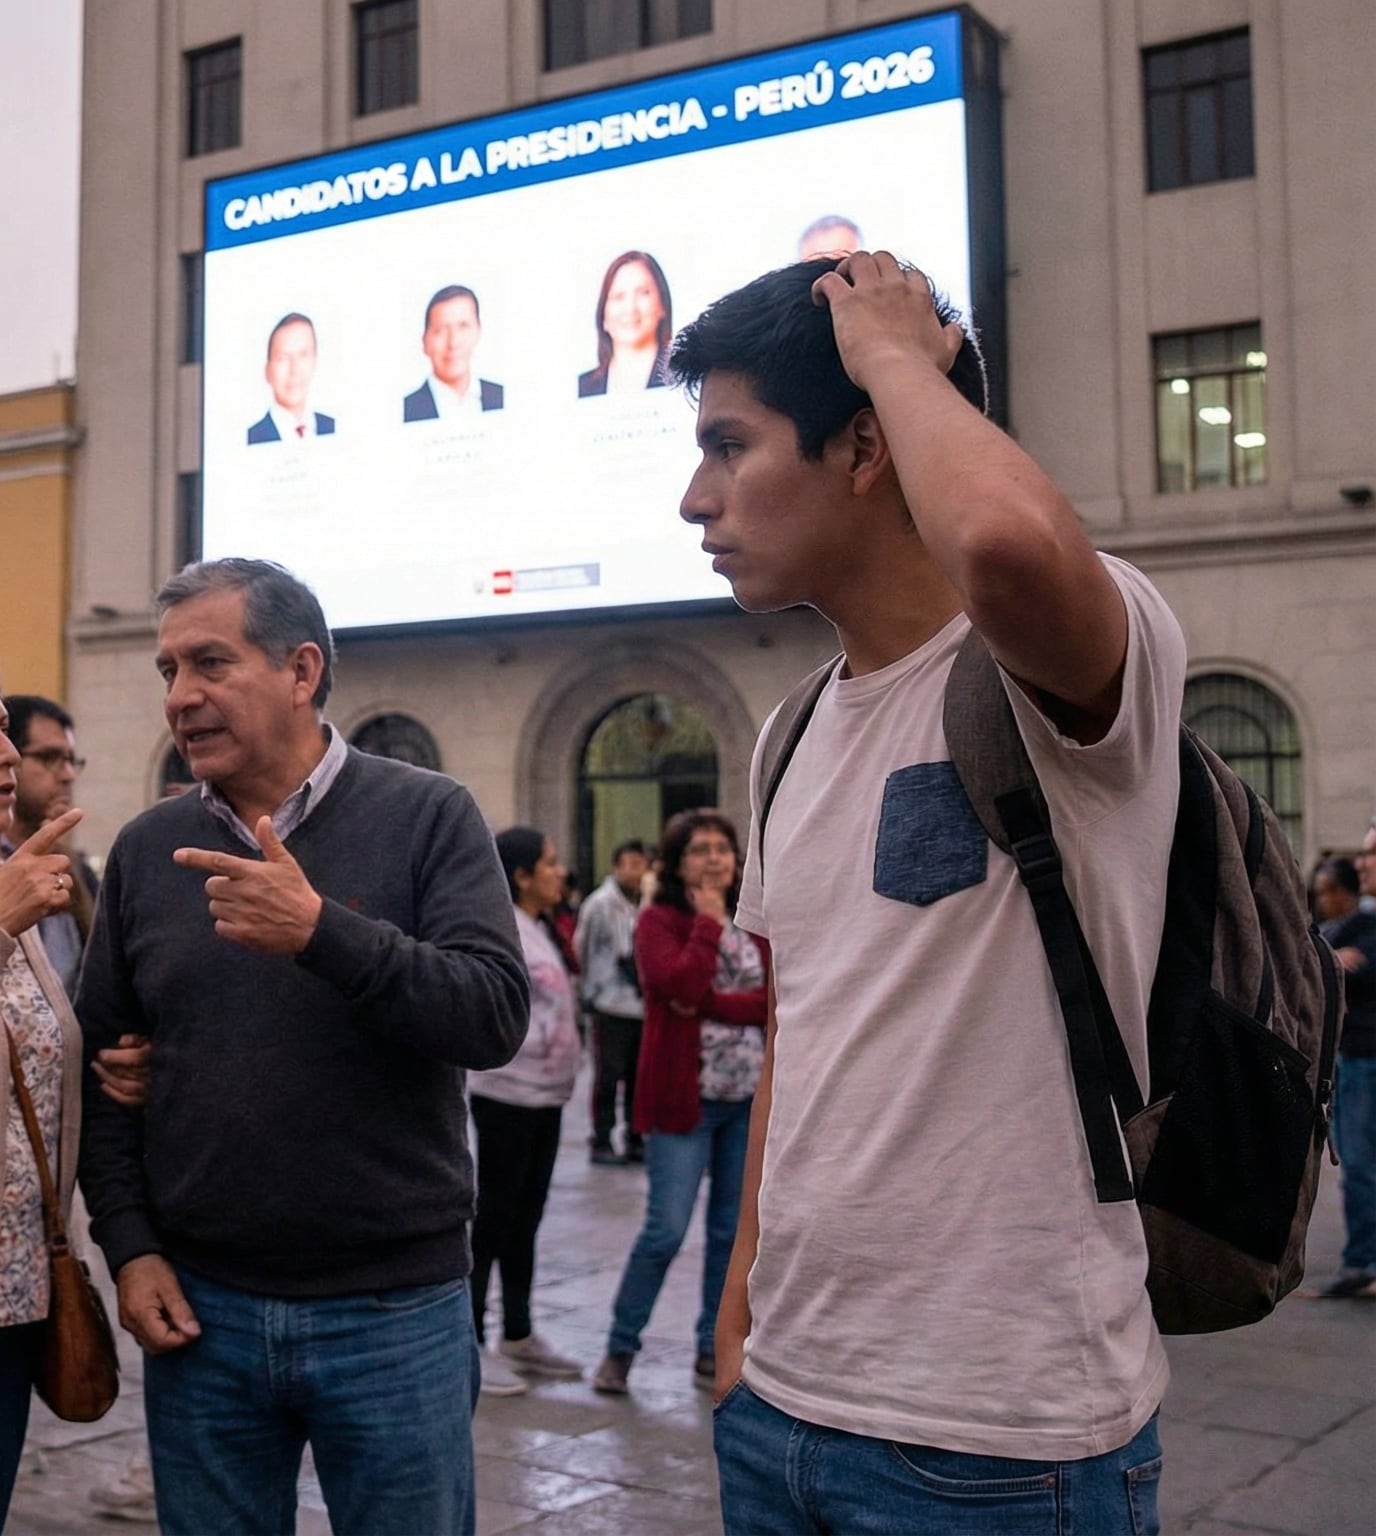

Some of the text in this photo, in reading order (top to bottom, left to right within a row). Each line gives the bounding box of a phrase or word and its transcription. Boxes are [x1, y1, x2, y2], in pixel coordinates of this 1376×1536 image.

[224, 162, 408, 230] CANDIDATOS
[411, 157, 437, 190] A
[440, 147, 483, 183] LA
[486, 98, 708, 174] PRESIDENCIA
[734, 60, 834, 121] PERÚ
[840, 46, 935, 98] 2026
